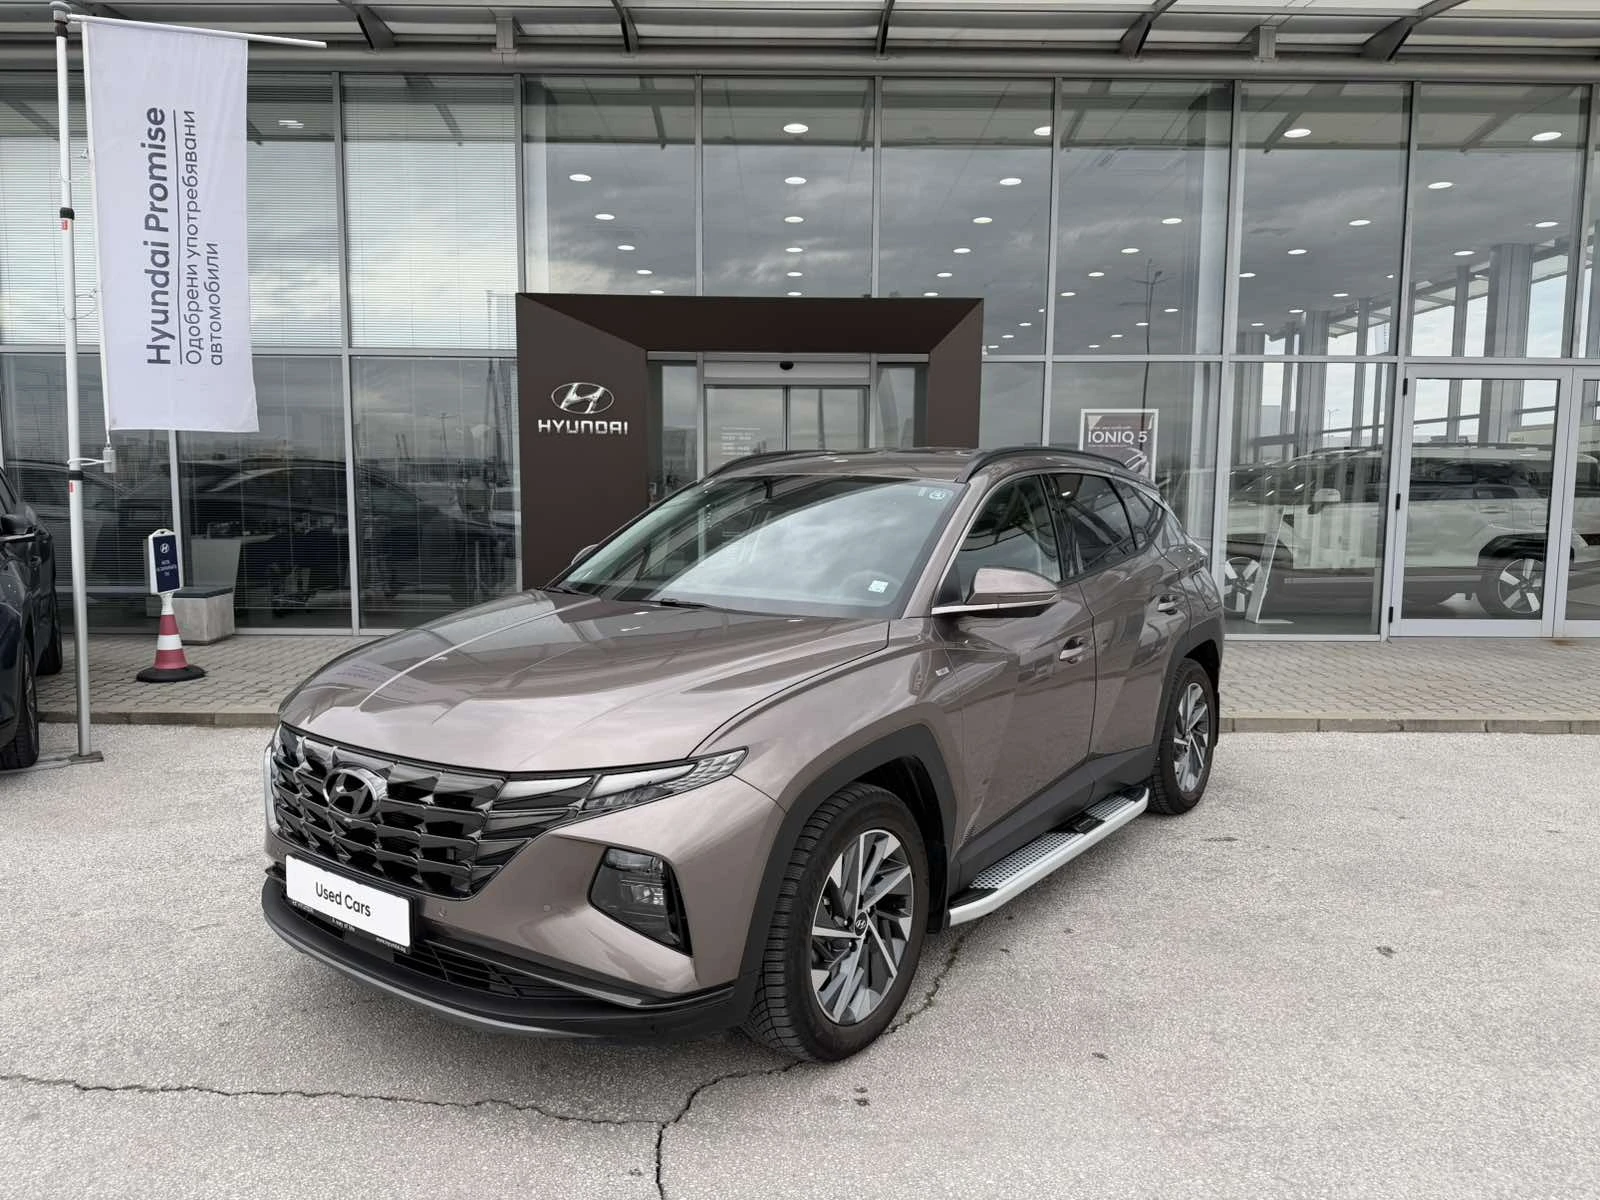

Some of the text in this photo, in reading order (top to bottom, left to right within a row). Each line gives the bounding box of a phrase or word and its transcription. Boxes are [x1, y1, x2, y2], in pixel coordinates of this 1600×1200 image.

[141, 107, 175, 365] Hyundai Promise
[181, 110, 204, 365] Одобрени употребявани
[204, 242, 224, 366] автомобили
[537, 419, 629, 435] HYUNDAI
[1088, 430, 1148, 445] IONIQ 5
[315, 882, 371, 917] Used Cars
